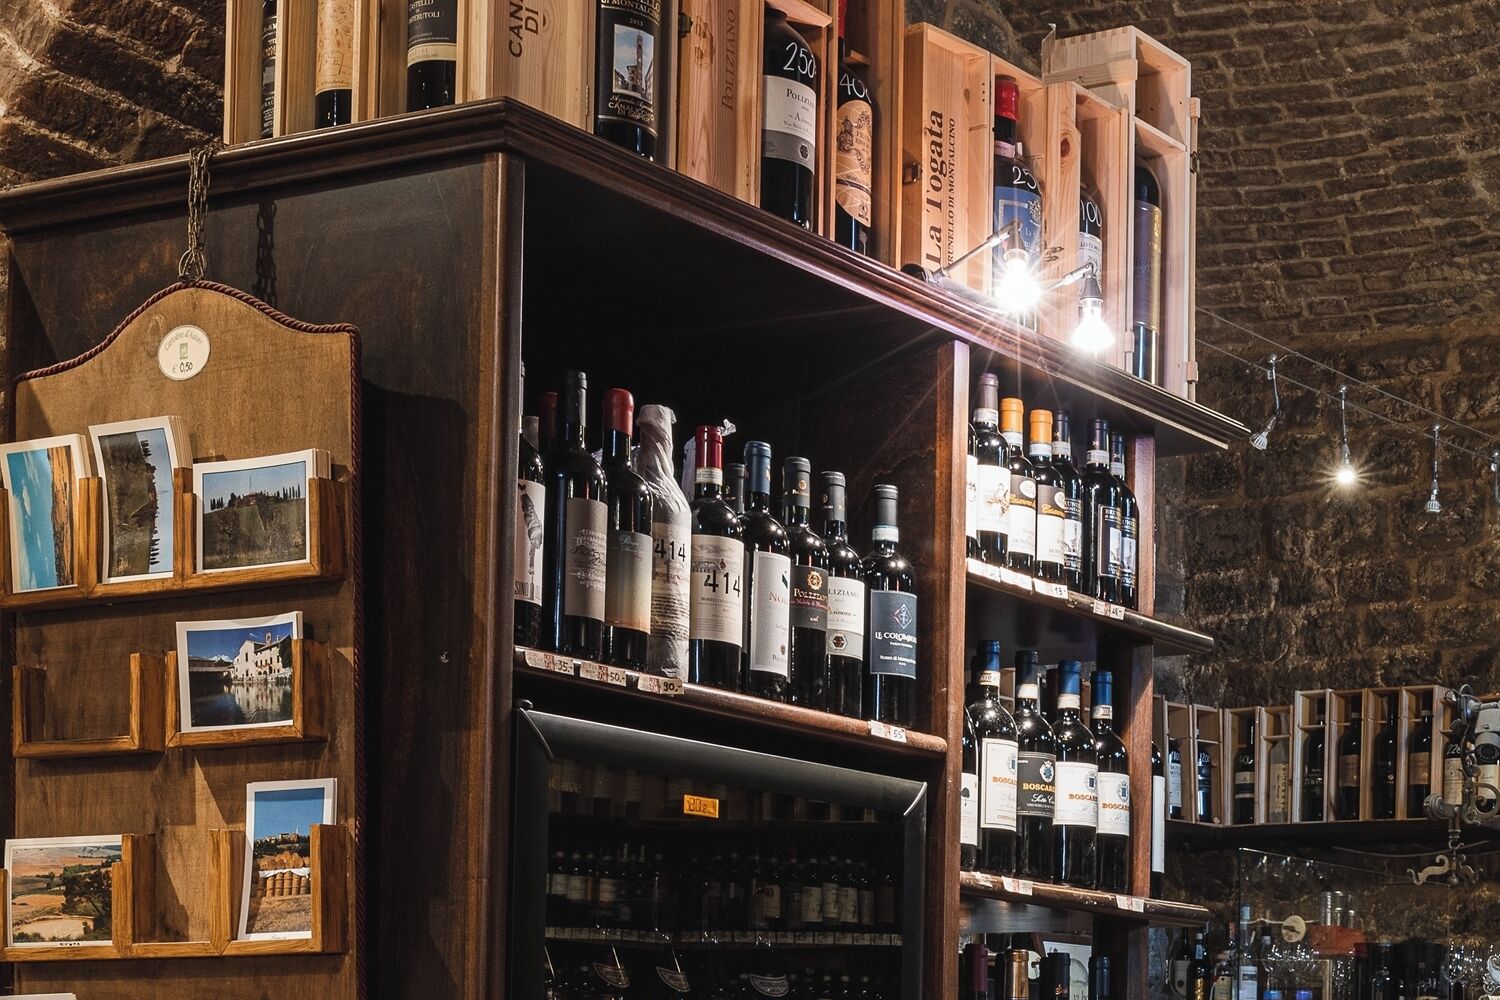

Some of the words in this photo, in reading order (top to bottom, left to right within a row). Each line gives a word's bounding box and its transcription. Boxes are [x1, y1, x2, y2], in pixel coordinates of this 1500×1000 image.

[509, 0, 525, 57] CAN
[525, 6, 539, 35] DI
[722, 9, 737, 111] POLIZIANO
[924, 110, 947, 214] Togata
[947, 118, 956, 195] MONTALCINO
[926, 226, 942, 265] La
[180, 361, 193, 373] 0,50
[654, 539, 687, 562] 414
[703, 569, 741, 597] 414
[828, 588, 859, 597] LIZIANO
[1068, 793, 1098, 801] BOSCAR
[1101, 802, 1129, 811] BOSCAR
[1073, 993, 1080, 1000] 12
